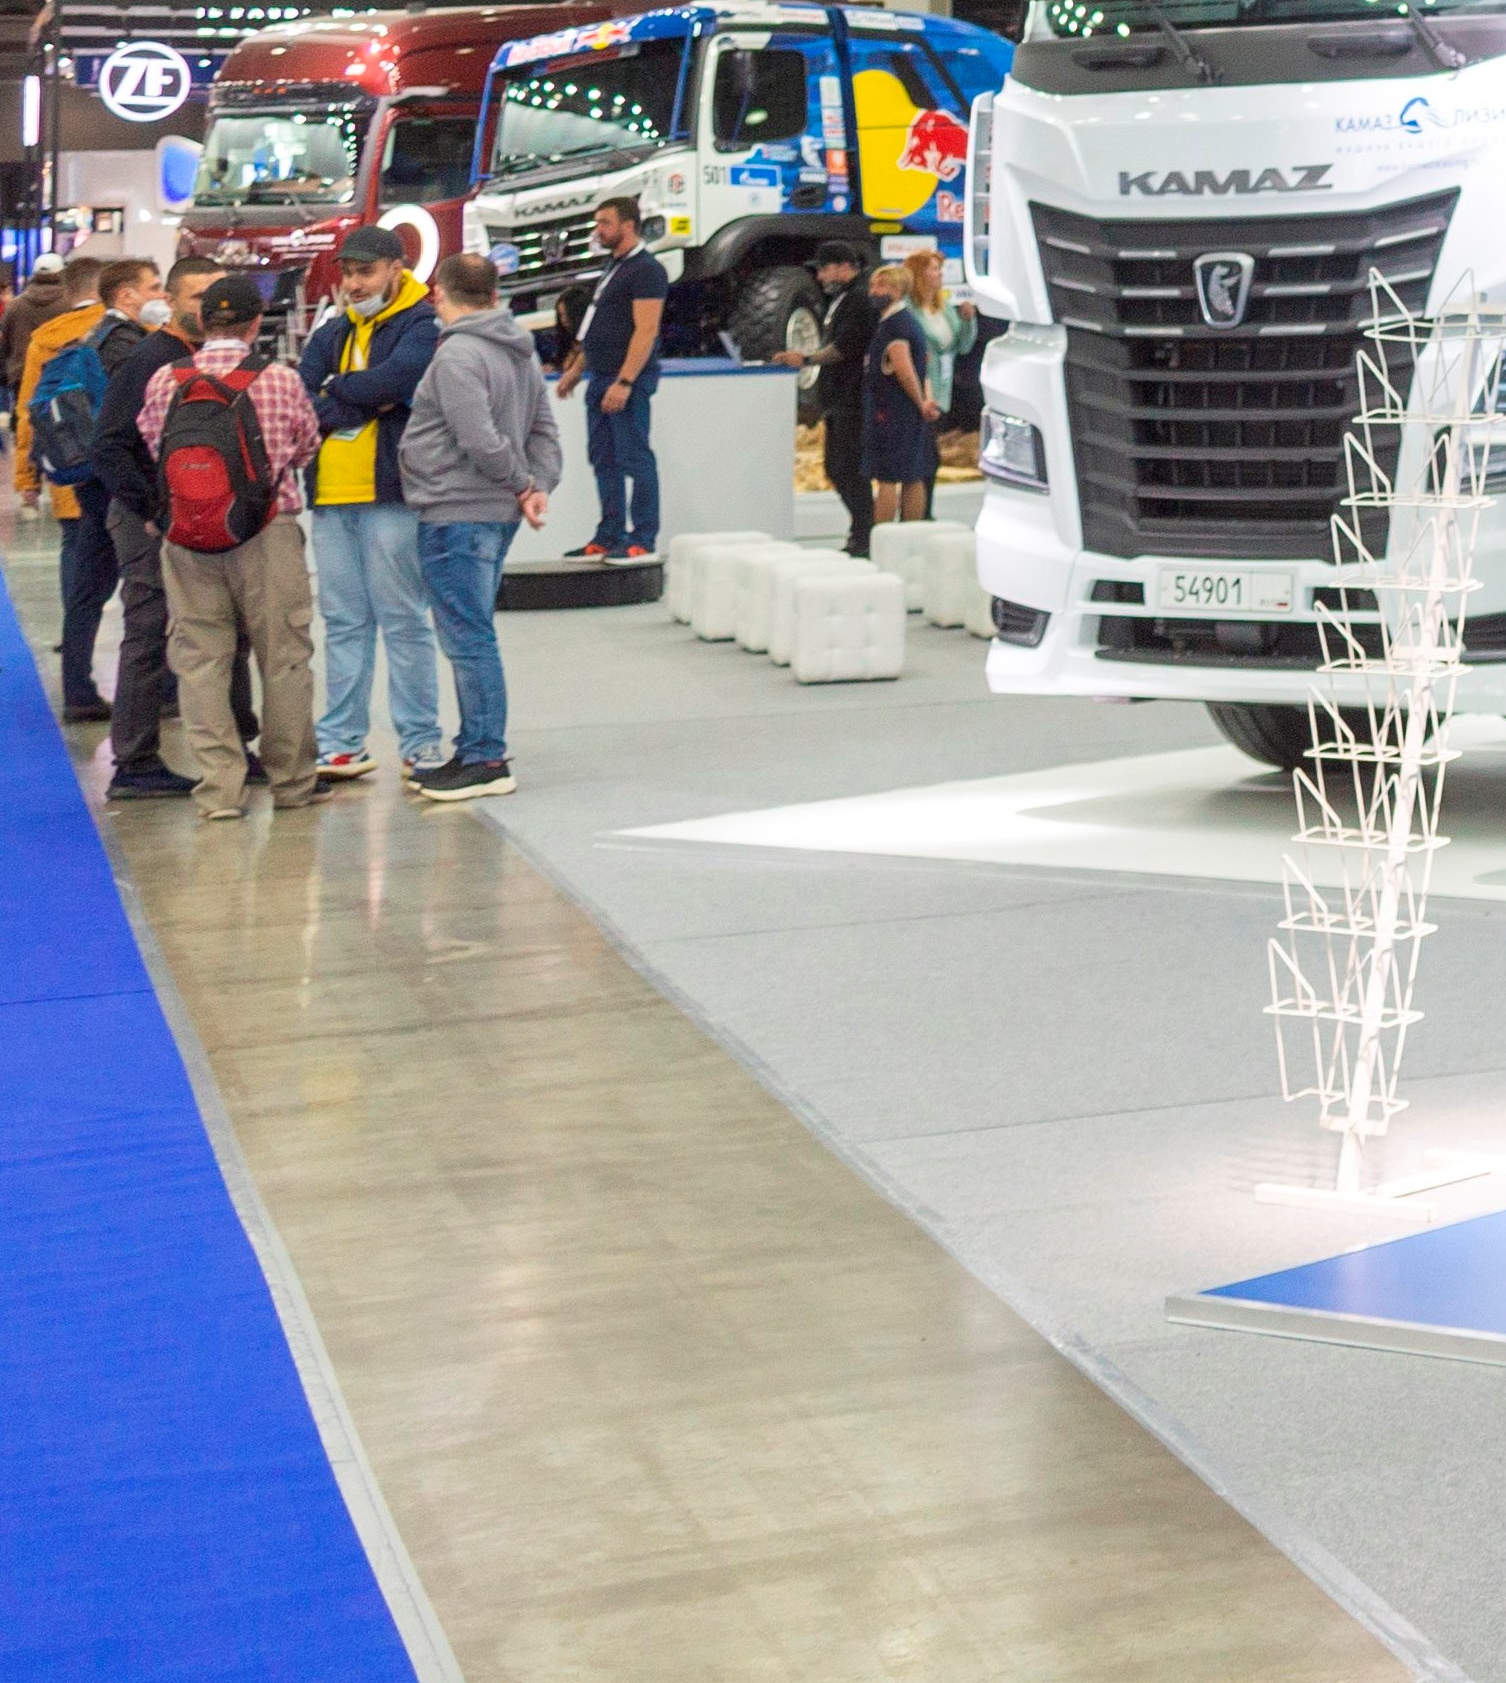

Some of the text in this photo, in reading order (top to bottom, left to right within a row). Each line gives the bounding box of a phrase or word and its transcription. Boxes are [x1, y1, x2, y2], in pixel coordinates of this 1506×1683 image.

[105, 54, 185, 108] ZF
[1118, 163, 1333, 197] KAMAZ
[515, 194, 596, 218] KAMAZ
[1174, 575, 1242, 605] 54901
